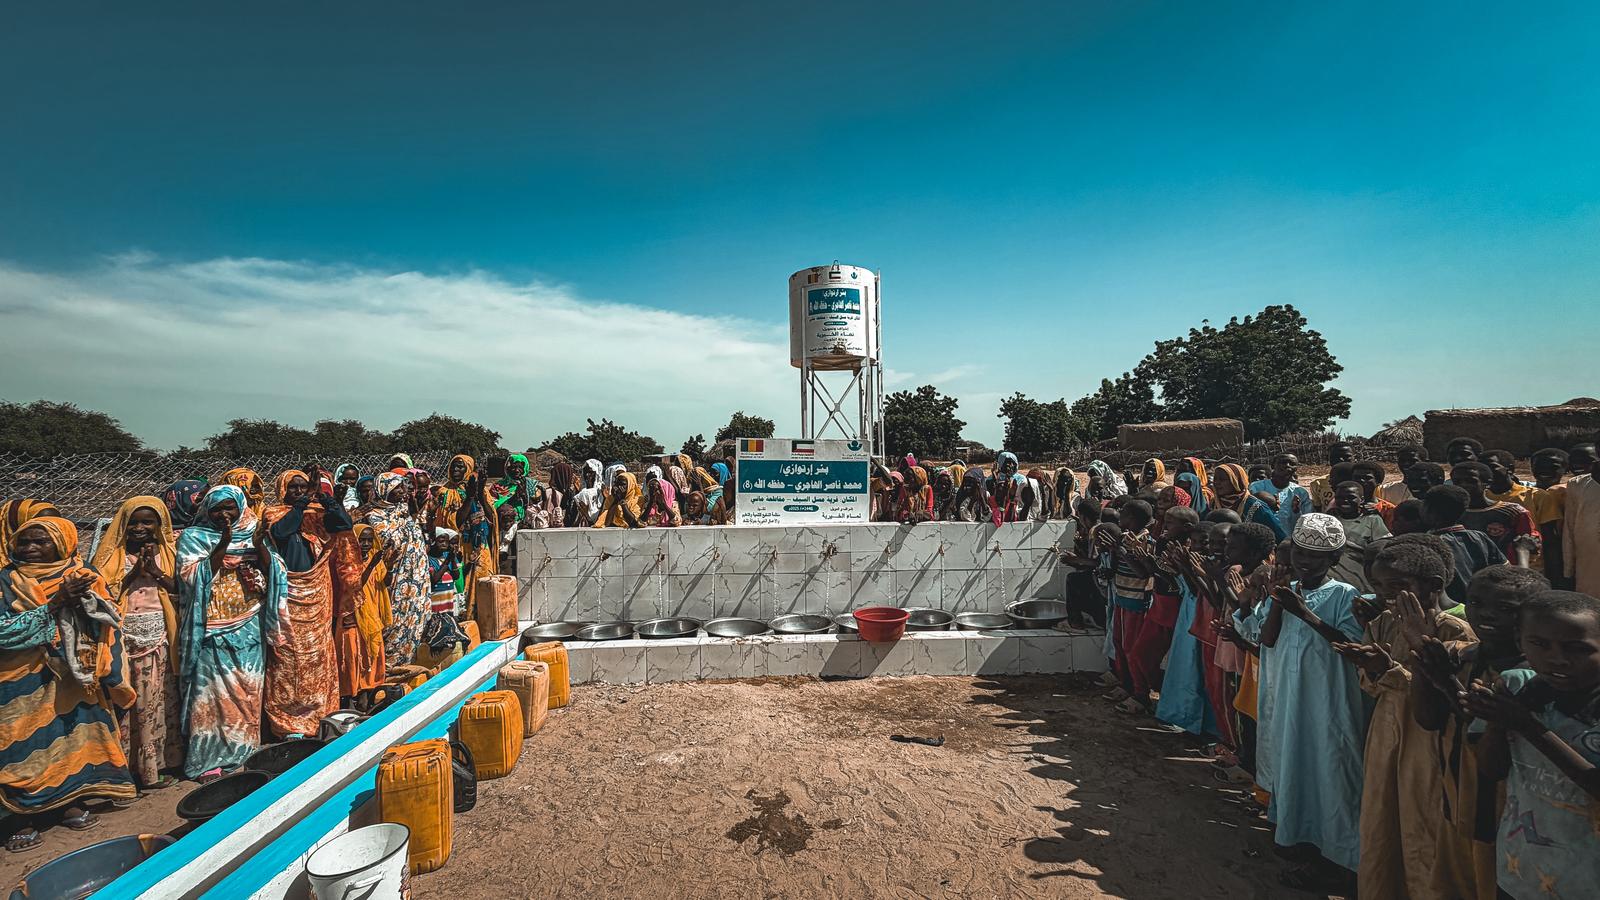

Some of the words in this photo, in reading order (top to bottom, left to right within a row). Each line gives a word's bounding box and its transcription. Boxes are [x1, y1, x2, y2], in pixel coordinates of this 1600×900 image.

[754, 478, 766, 490] الله
[794, 480, 823, 493] الهاجري
[824, 480, 842, 492] ناصر
[843, 480, 863, 490] محمد
